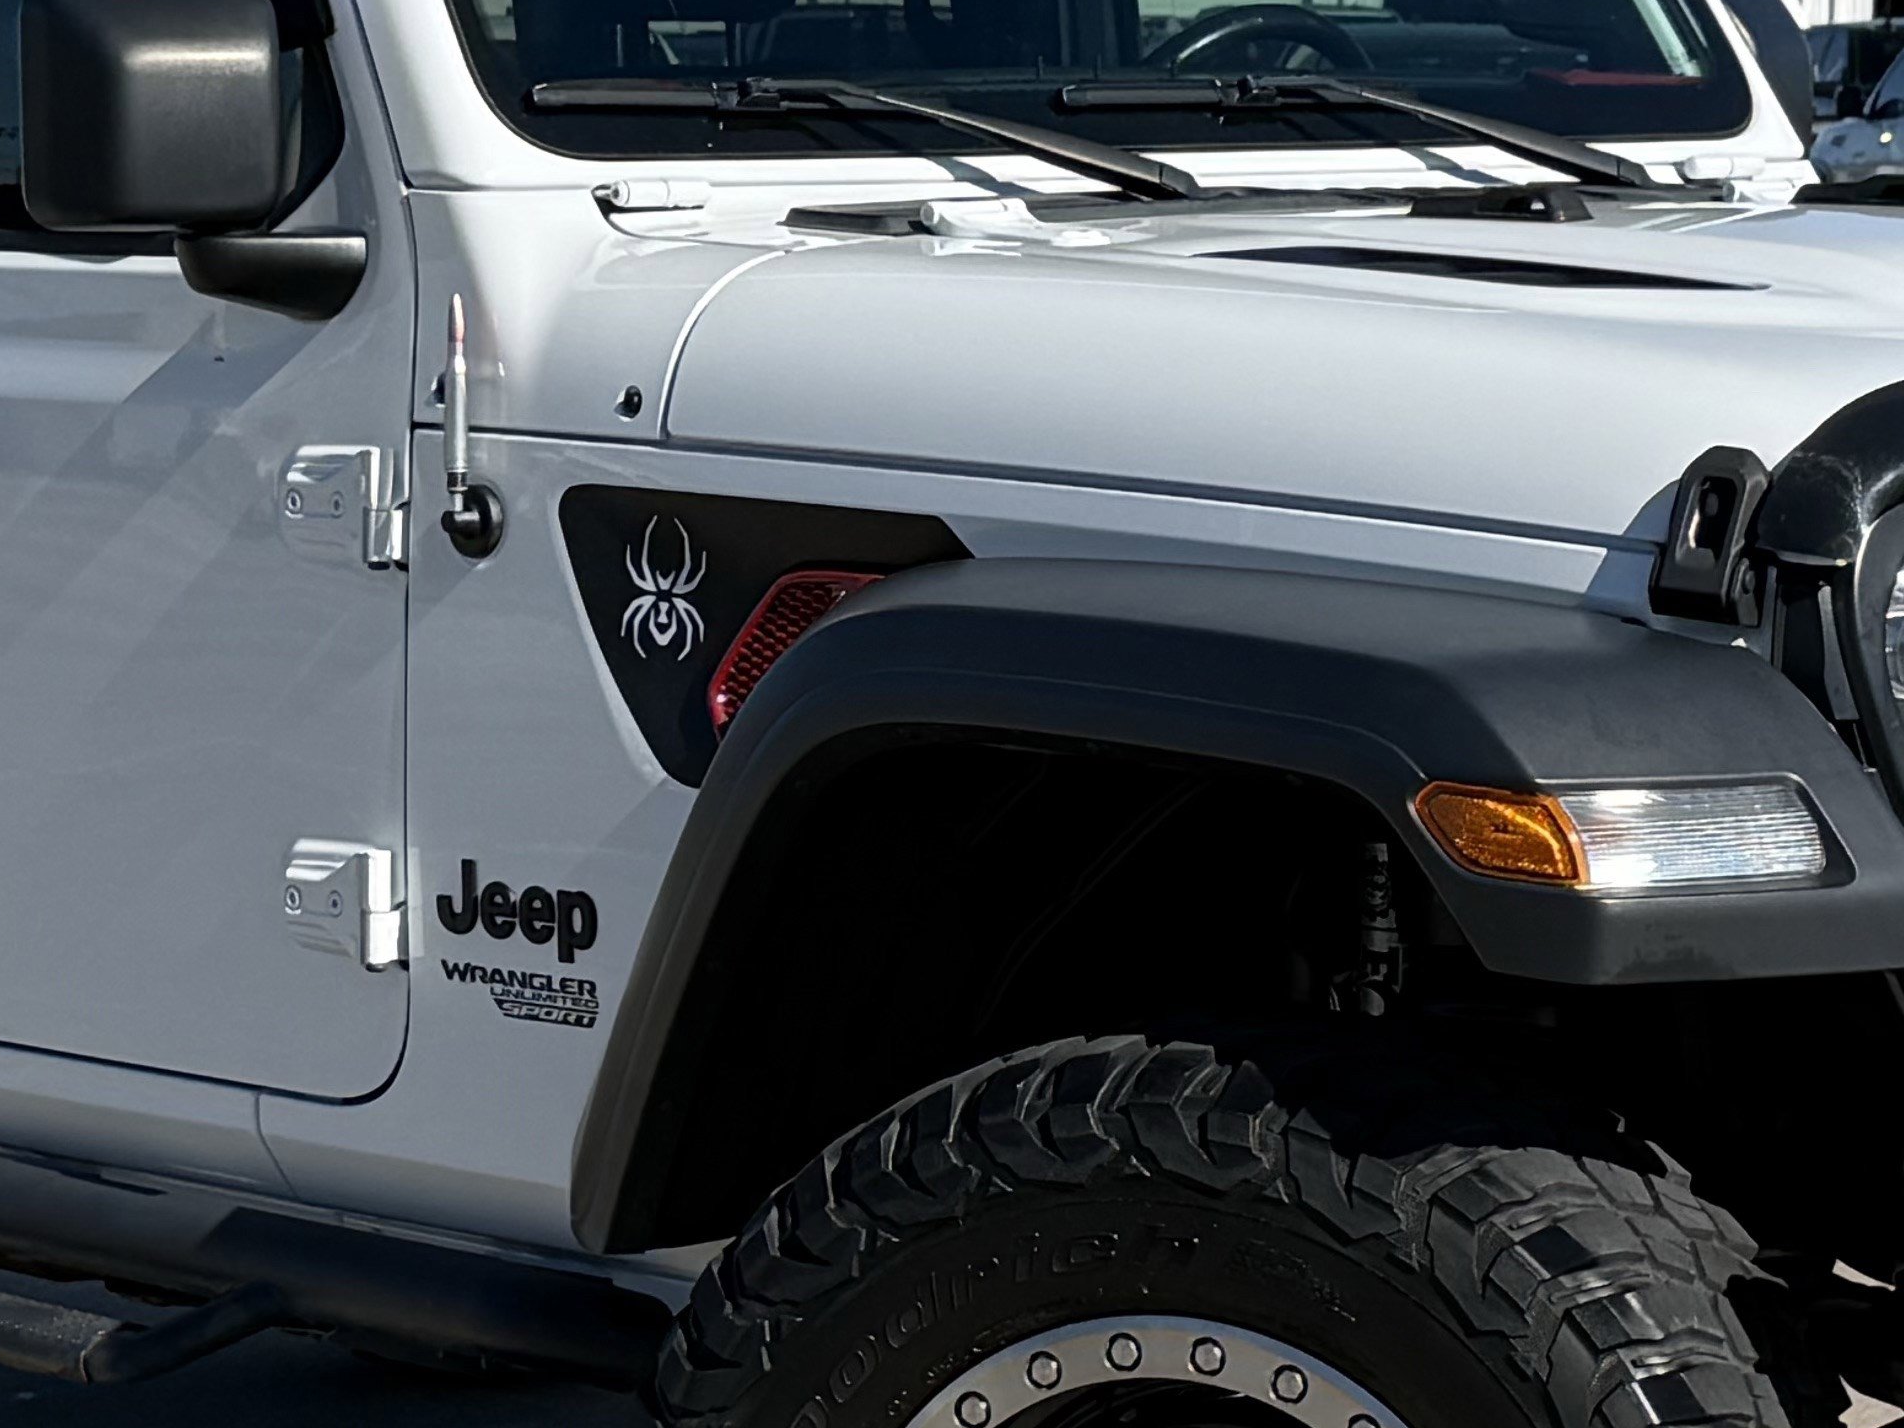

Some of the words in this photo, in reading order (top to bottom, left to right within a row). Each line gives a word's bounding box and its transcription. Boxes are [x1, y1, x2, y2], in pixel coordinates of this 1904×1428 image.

[436, 858, 599, 964] Jeep
[440, 958, 598, 999] WRANGLER
[490, 986, 599, 1010] UNLIMITED
[498, 1002, 598, 1027] SPORT
